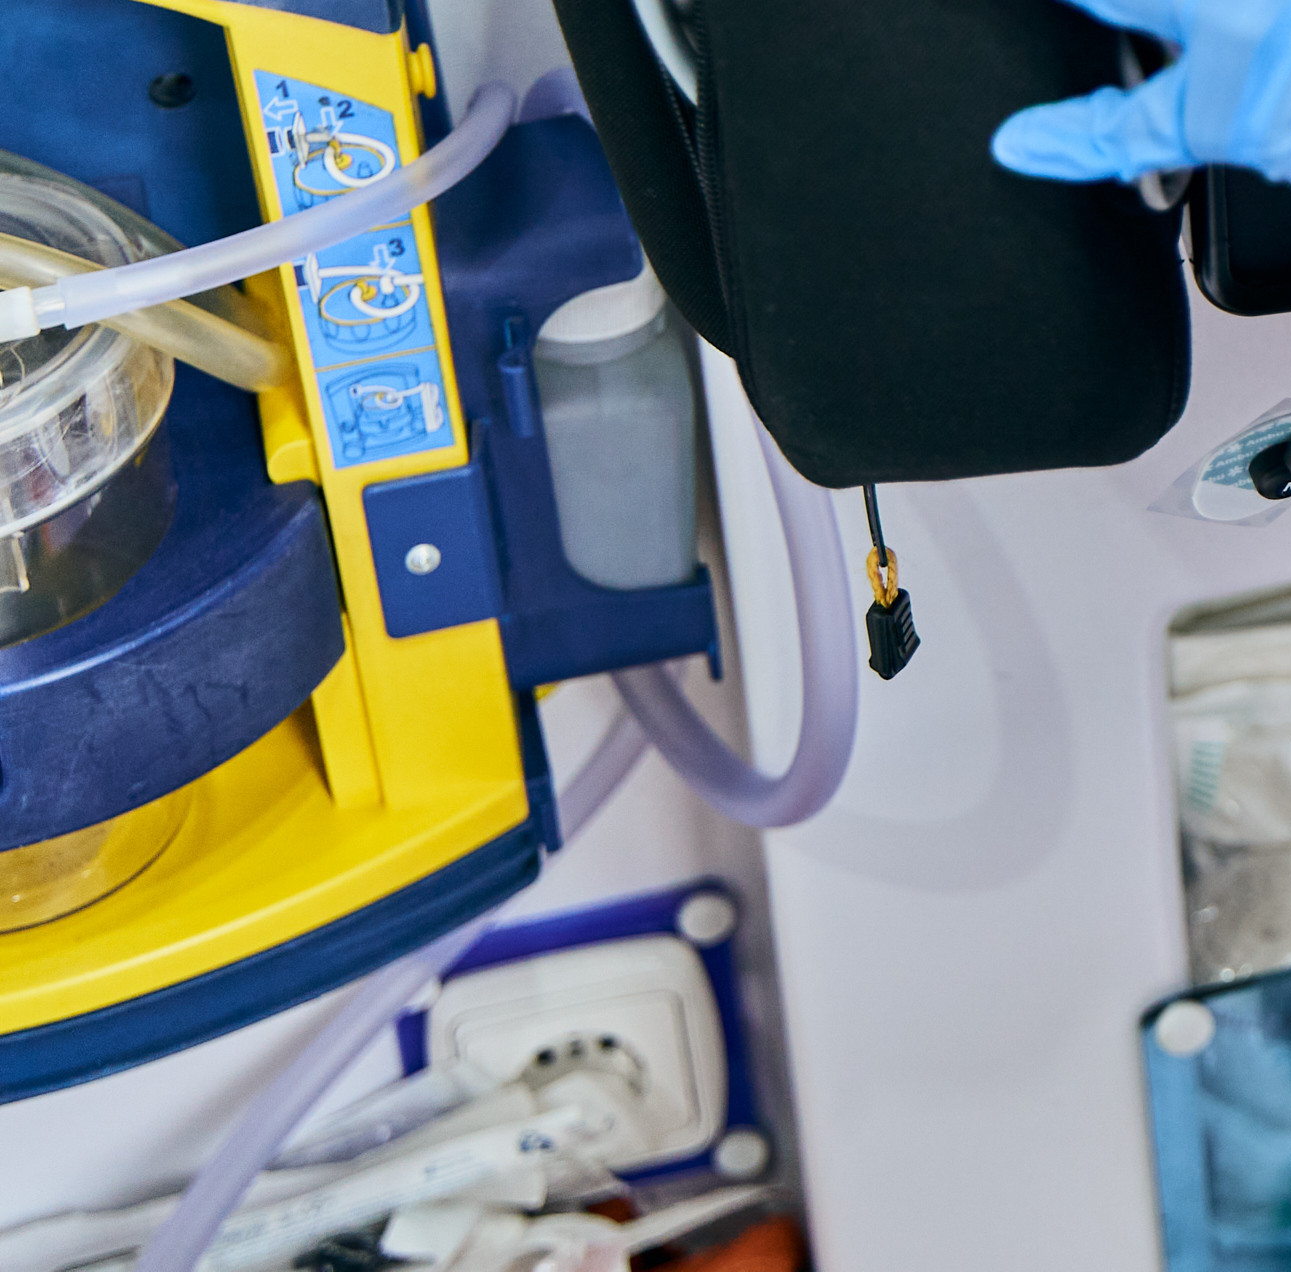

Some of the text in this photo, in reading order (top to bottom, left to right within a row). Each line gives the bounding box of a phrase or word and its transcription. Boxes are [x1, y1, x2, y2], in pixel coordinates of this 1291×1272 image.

[275, 80, 291, 99] 1
[337, 100, 354, 118] 2
[388, 239, 406, 257] 3
